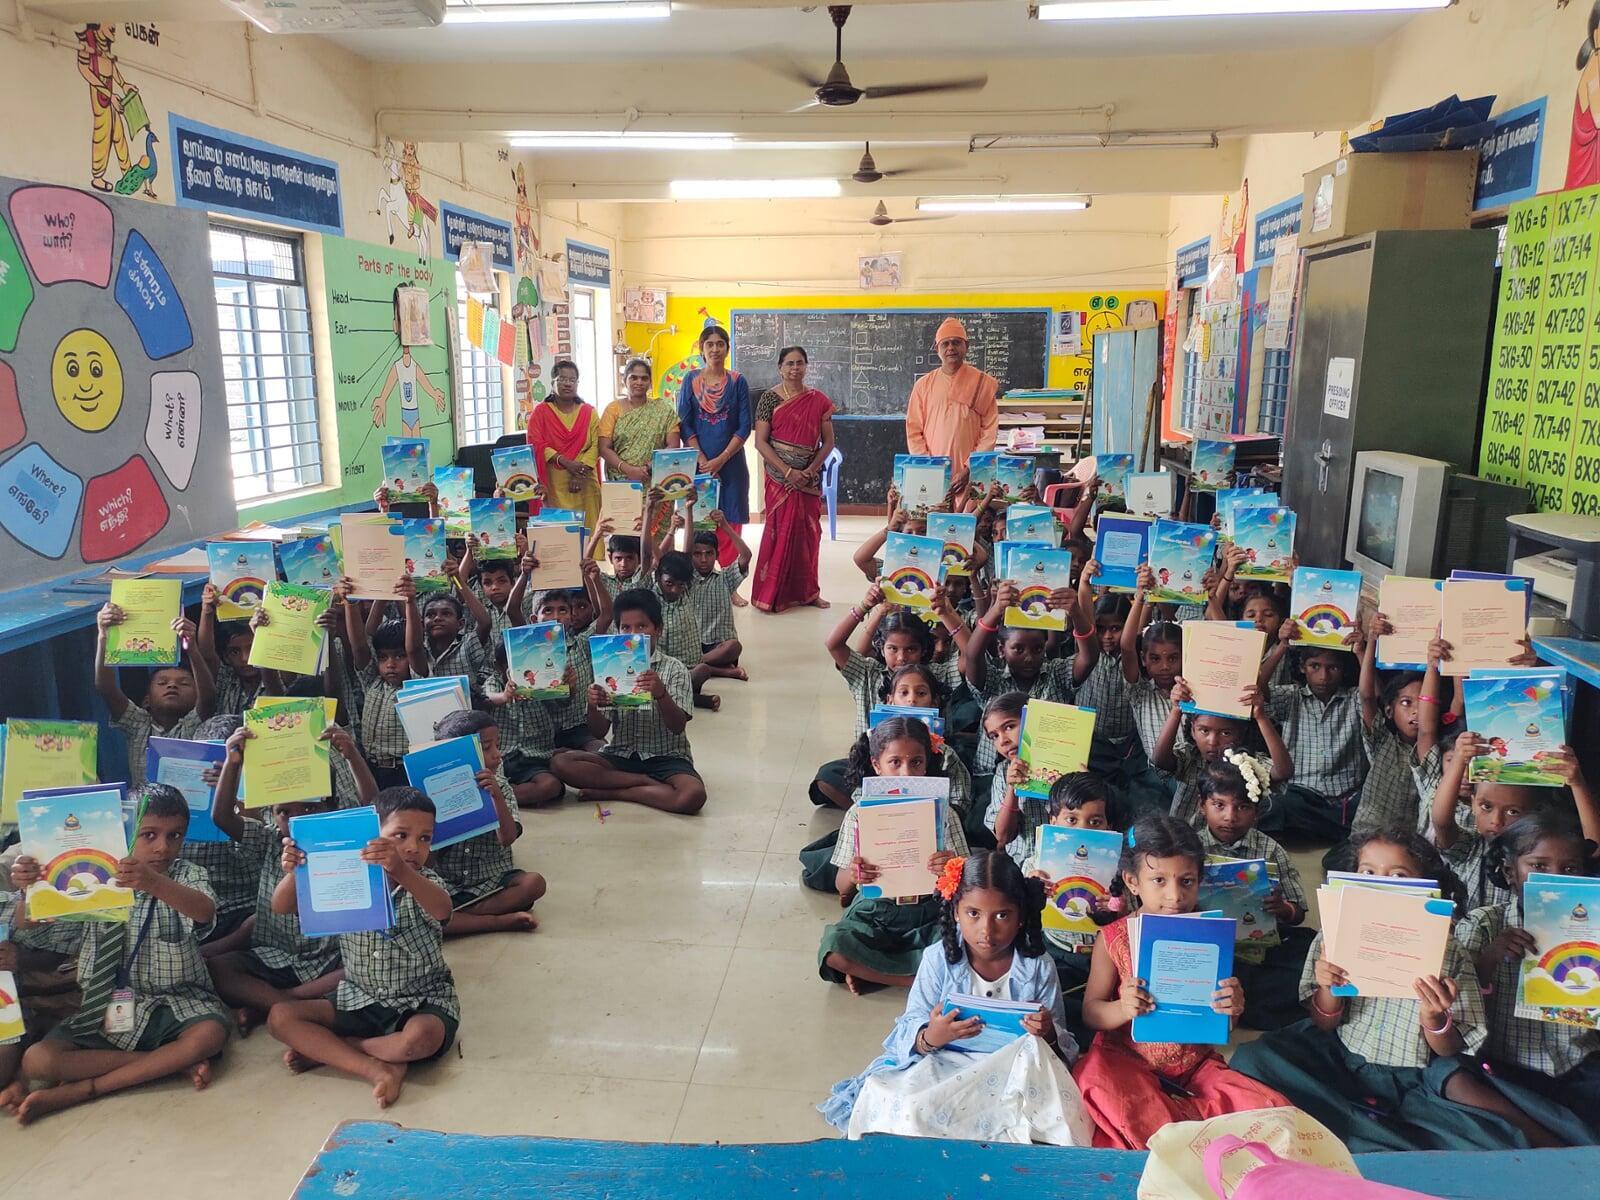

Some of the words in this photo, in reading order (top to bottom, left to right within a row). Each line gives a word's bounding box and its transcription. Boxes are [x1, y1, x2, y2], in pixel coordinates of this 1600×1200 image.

[183, 139, 223, 165] வாய்மை
[186, 159, 212, 190] தீமை
[44, 212, 76, 228] Who?
[358, 255, 381, 275] Parts
[398, 263, 410, 279] the
[414, 266, 433, 286] body
[332, 289, 350, 305] Head
[31, 464, 67, 498] Where?
